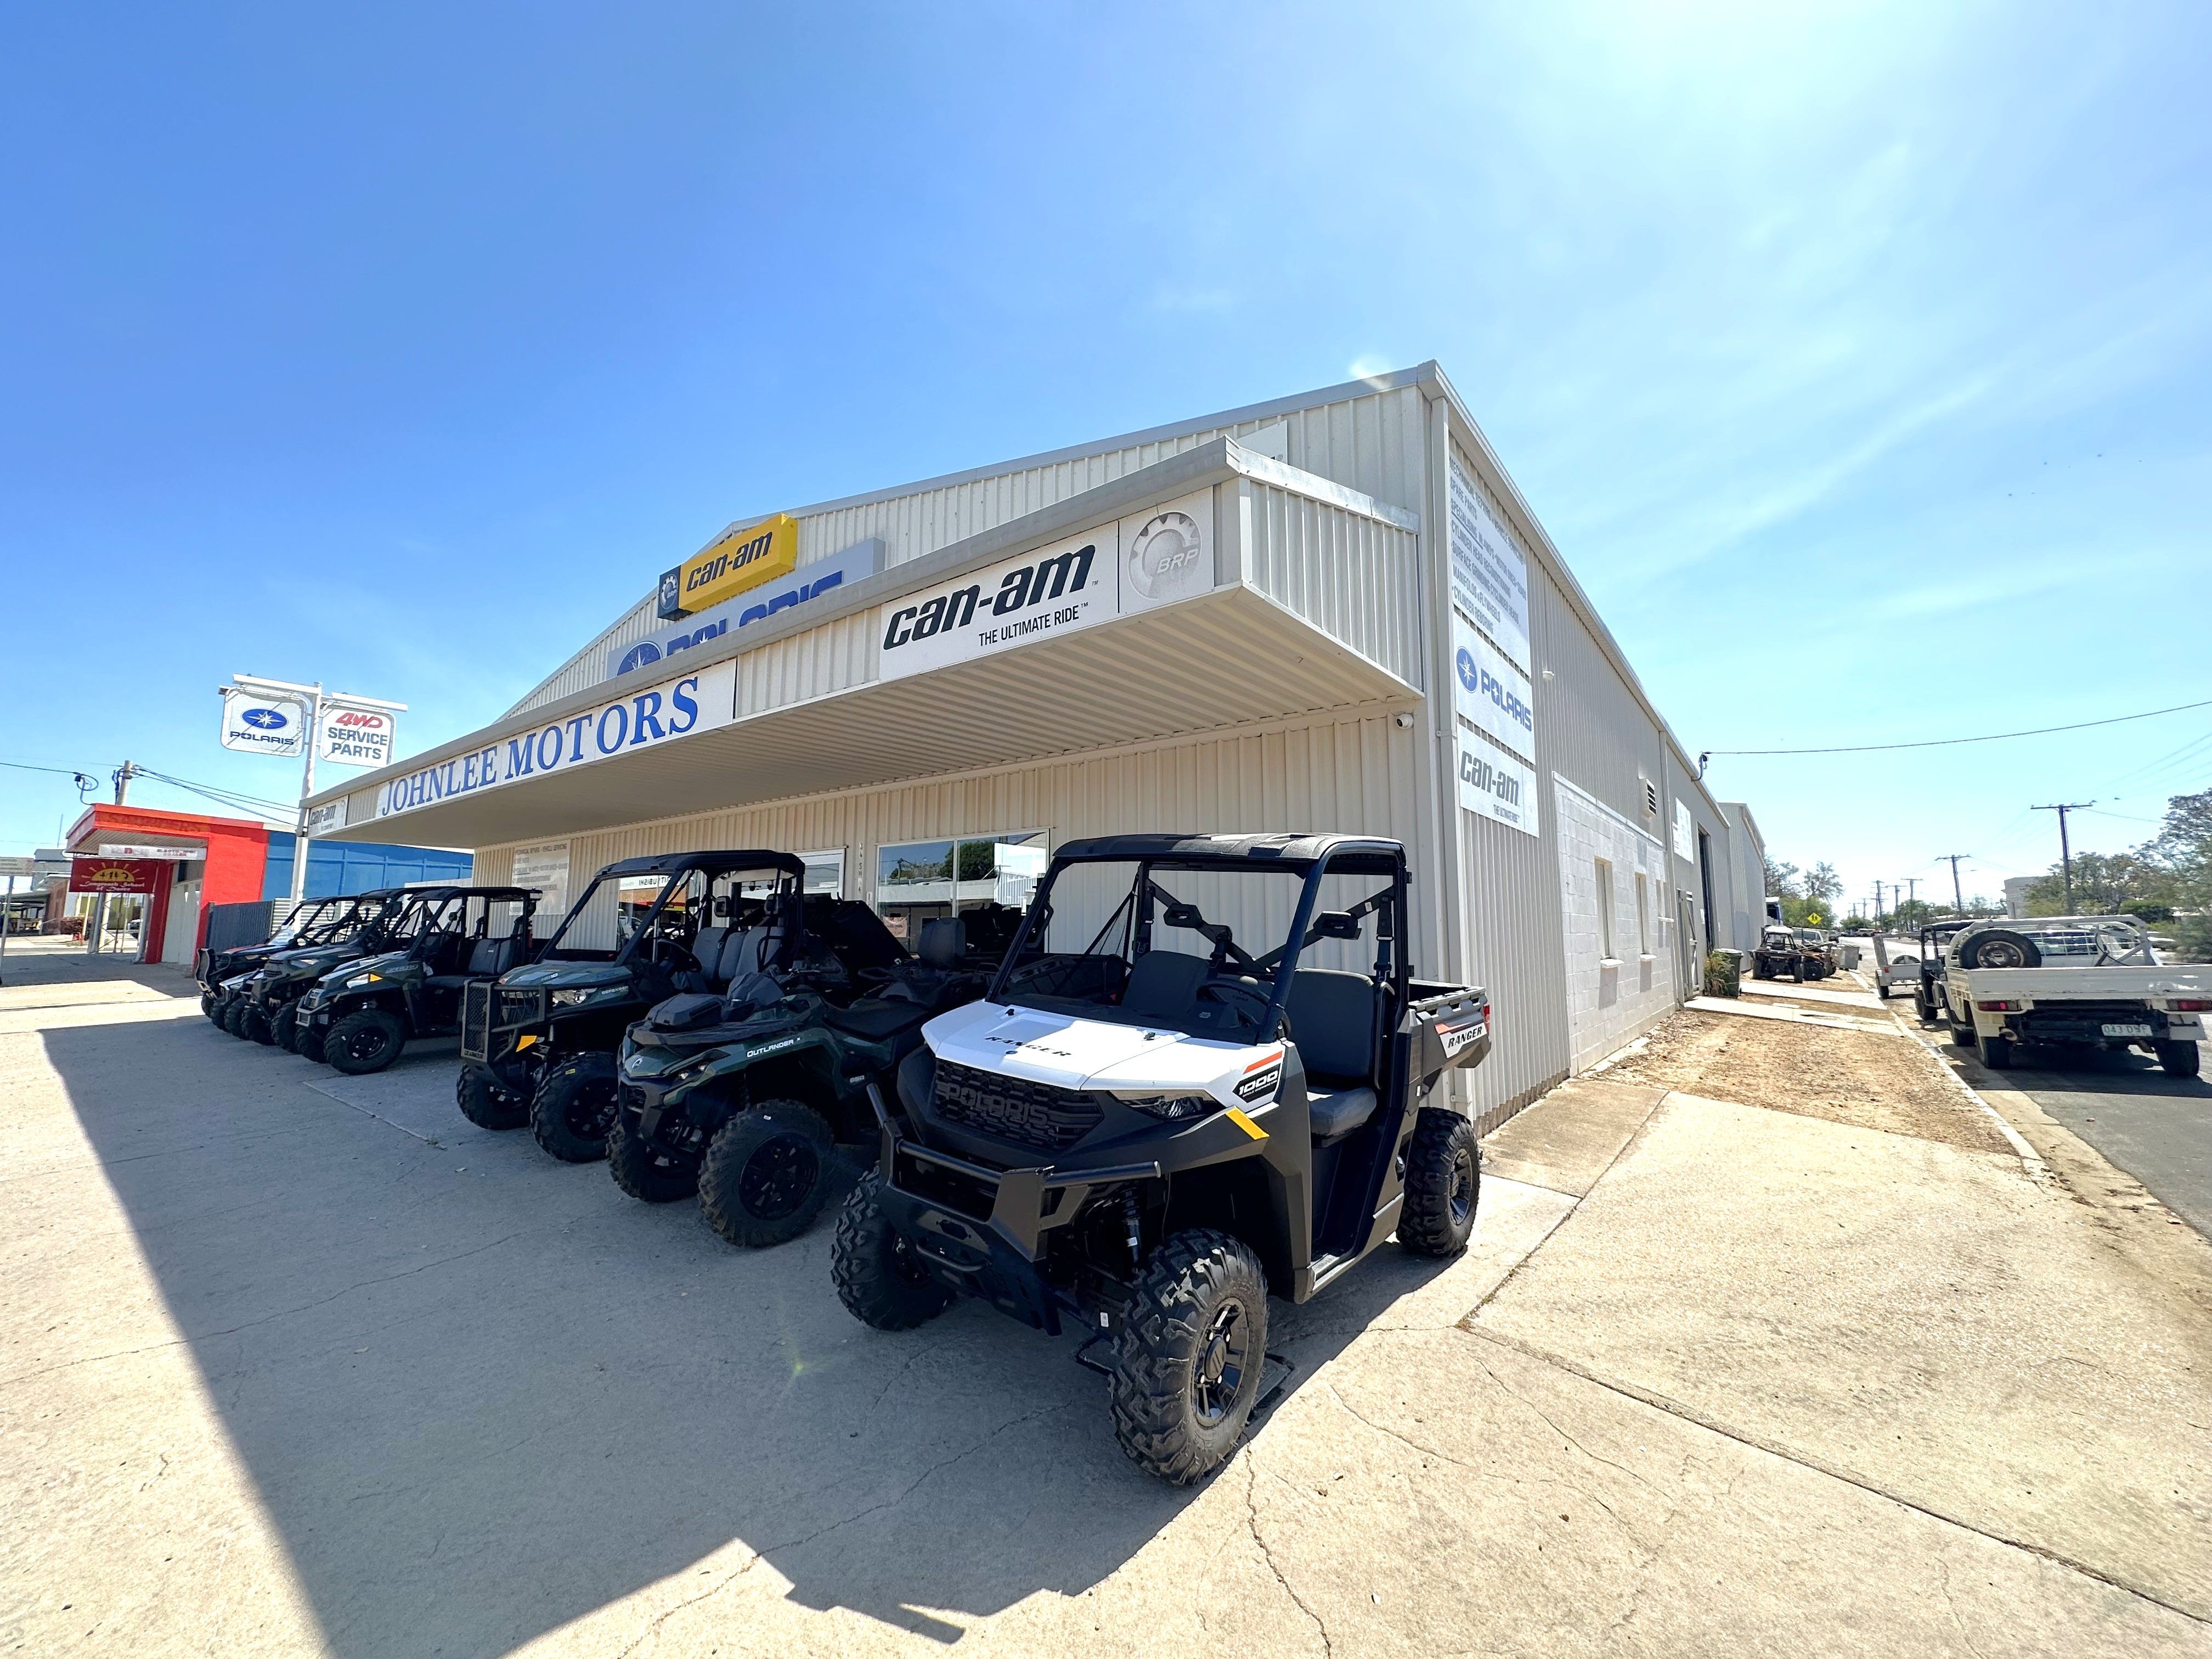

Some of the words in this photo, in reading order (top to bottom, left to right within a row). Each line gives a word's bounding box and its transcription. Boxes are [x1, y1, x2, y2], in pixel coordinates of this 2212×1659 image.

[686, 532, 772, 591] can-am
[1156, 548, 1199, 575] BRP
[883, 545, 1096, 650] can-am
[978, 629, 997, 646] THE
[1001, 613, 1051, 640] ULTIMATE
[1054, 605, 1079, 626] RIDE
[1481, 668, 1532, 732] POLARIS
[335, 713, 383, 728] 4WD
[230, 731, 294, 746] POLARIS
[328, 727, 388, 746] SERVICE
[382, 746, 498, 816] JOHNLEE
[505, 676, 698, 779] MOTORS
[331, 743, 382, 759] PARTS
[1460, 751, 1519, 806] can-am
[747, 1039, 794, 1058] OUTLANDER
[985, 1037, 1071, 1057] RANGER
[1448, 1026, 1482, 1048] RANGER
[1239, 1070, 1278, 1096] 1000
[943, 1081, 1048, 1129] POLARIS
